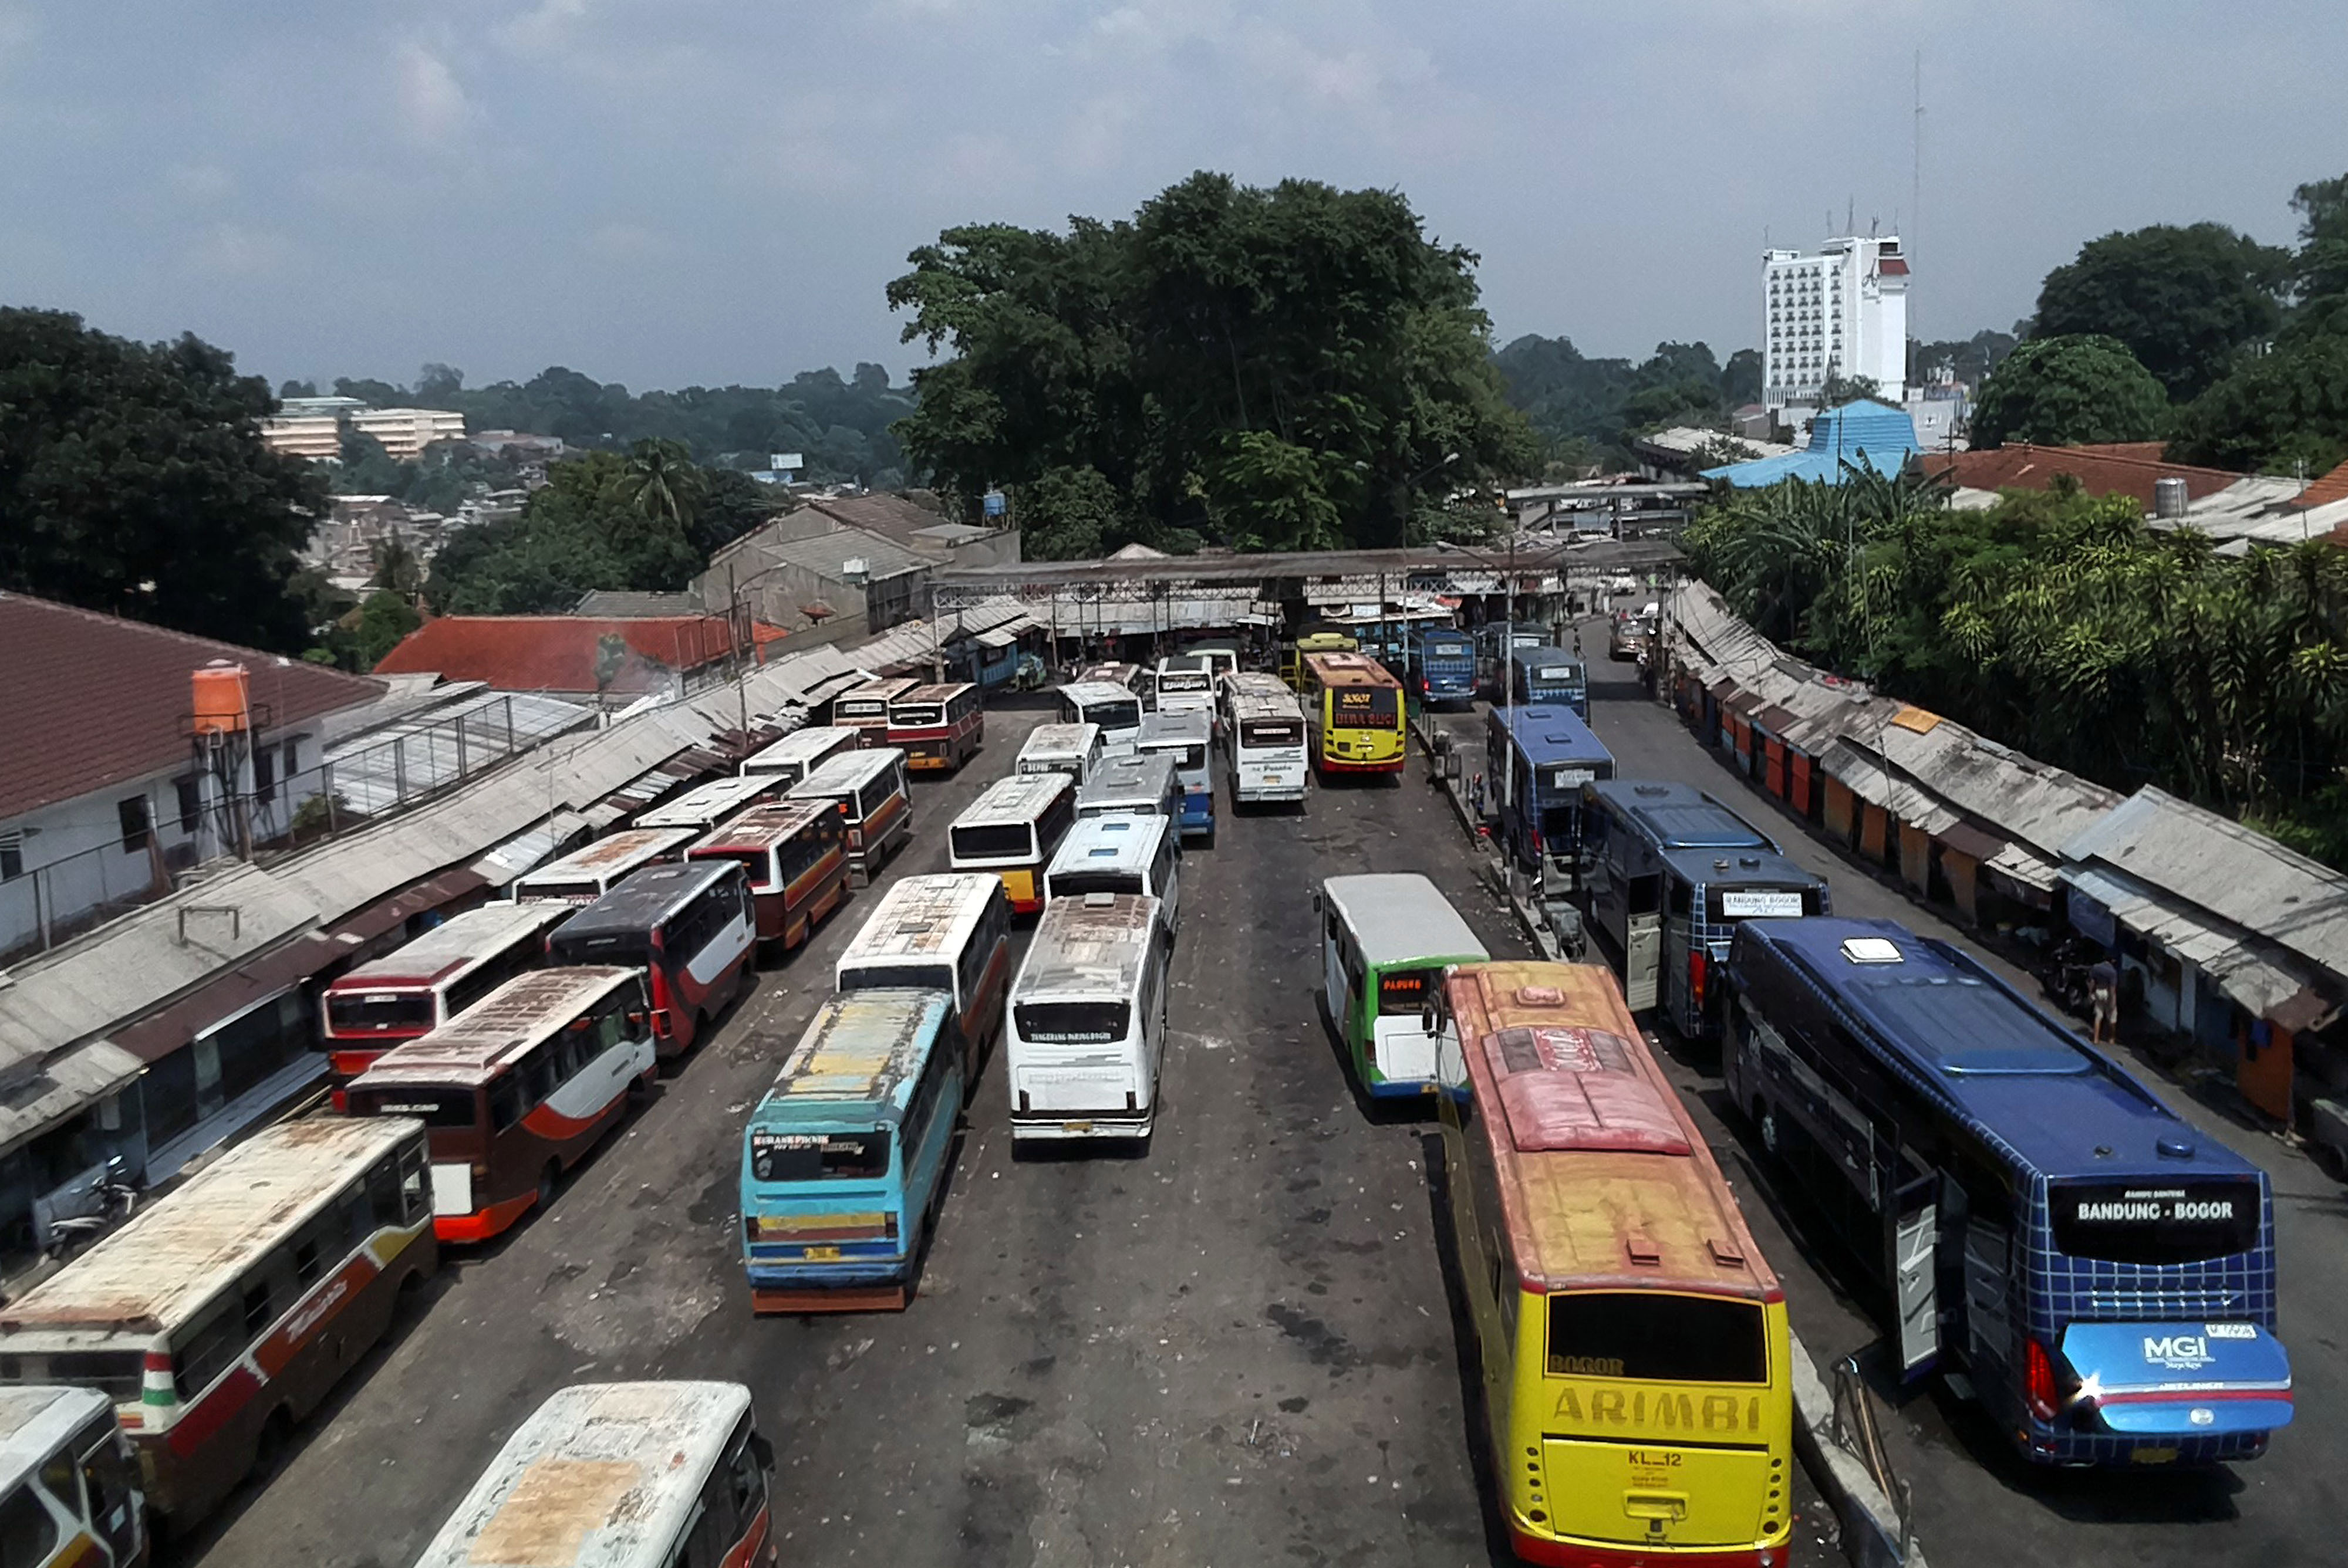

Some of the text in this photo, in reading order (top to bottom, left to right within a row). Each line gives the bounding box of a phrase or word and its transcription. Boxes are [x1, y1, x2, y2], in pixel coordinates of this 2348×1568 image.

[2078, 1202, 2161, 1221] BANDUNG
[2174, 1201, 2233, 1219] BOGOR
[2144, 1336, 2207, 1358] MGI
[1548, 1354, 1625, 1376] BOGOR
[1553, 1387, 1760, 1432] ARIMBI
